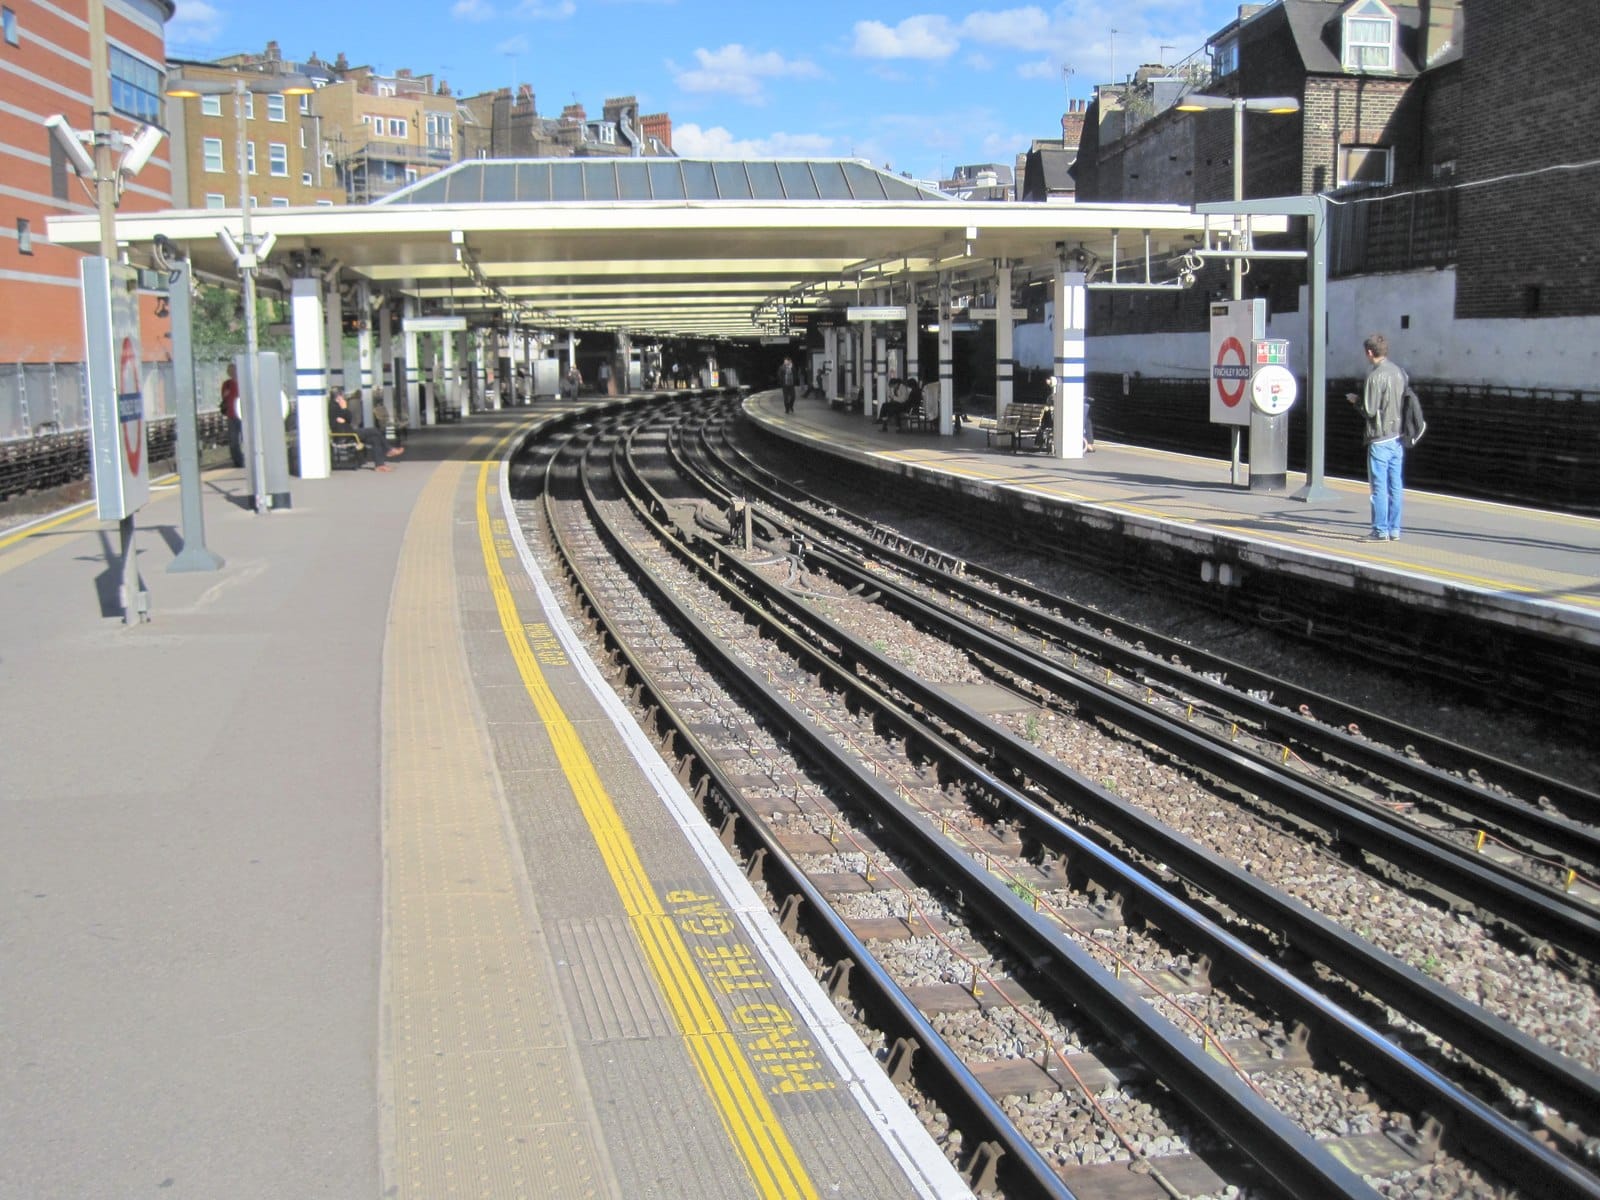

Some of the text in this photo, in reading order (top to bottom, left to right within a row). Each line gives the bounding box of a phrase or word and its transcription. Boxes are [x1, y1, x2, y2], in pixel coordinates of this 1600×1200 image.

[665, 890, 836, 1094] MIND THE GAP
